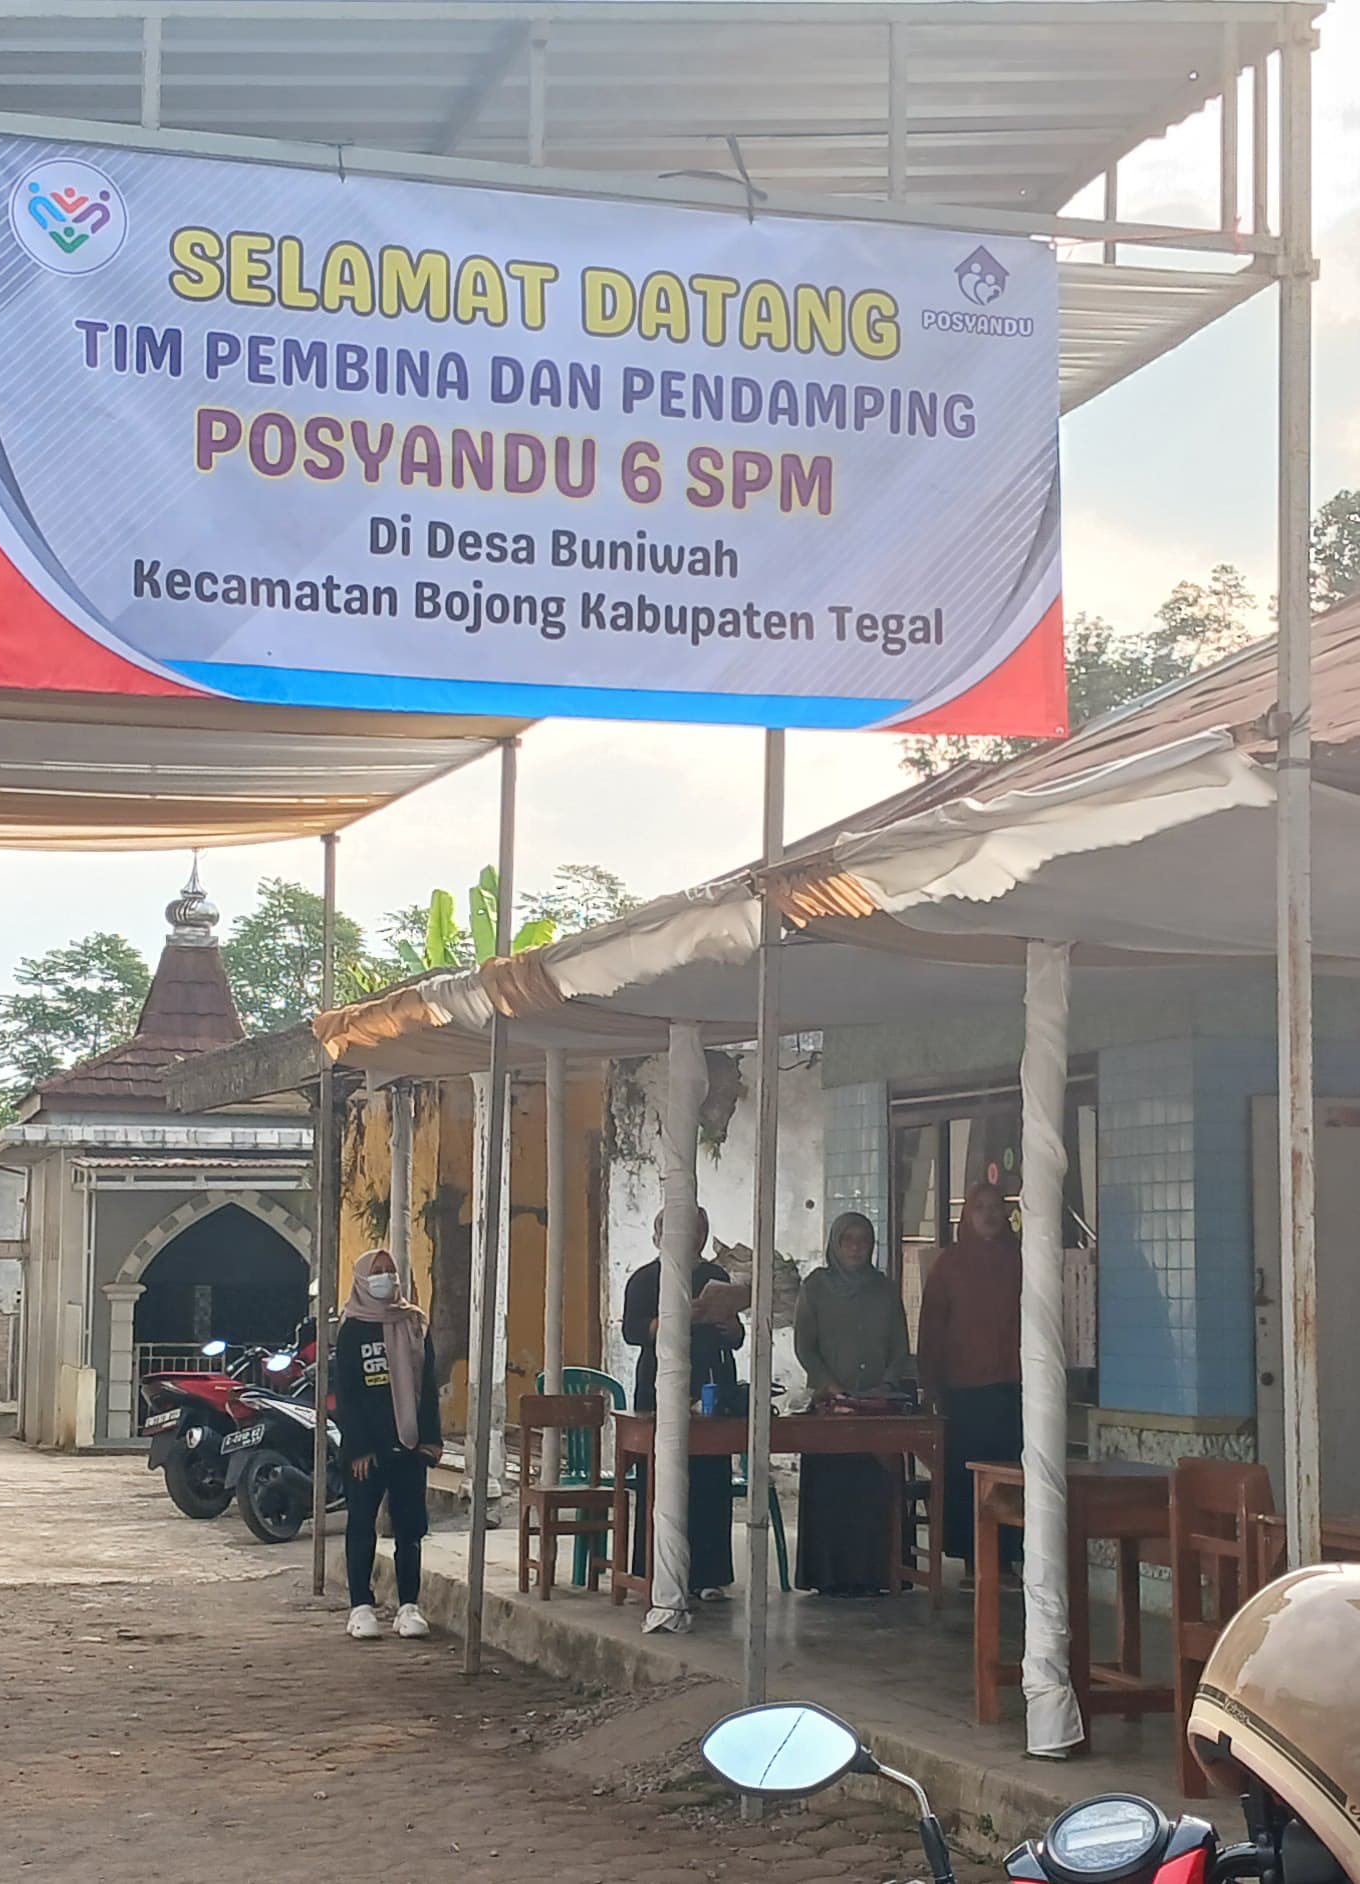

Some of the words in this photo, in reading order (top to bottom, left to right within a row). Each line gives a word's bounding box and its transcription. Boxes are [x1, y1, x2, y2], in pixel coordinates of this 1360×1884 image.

[169, 226, 559, 331] SELAMAT
[581, 266, 900, 360] DATANG
[922, 309, 1034, 337] POSYANDU
[75, 319, 182, 378] TIM
[206, 331, 469, 401] PEMBINA
[491, 356, 601, 411] DAN
[622, 366, 976, 439] PENDAMPING
[195, 407, 596, 499] POSYANDU
[621, 440, 662, 504] 6
[686, 446, 833, 516] SPM
[369, 513, 412, 556] Di
[427, 520, 536, 565] Desa
[551, 529, 738, 578] Buniwah
[133, 558, 398, 617] Kecamatan
[414, 580, 566, 640] Bojong
[580, 592, 815, 646] Kabupaten
[828, 606, 944, 656] Tegal
